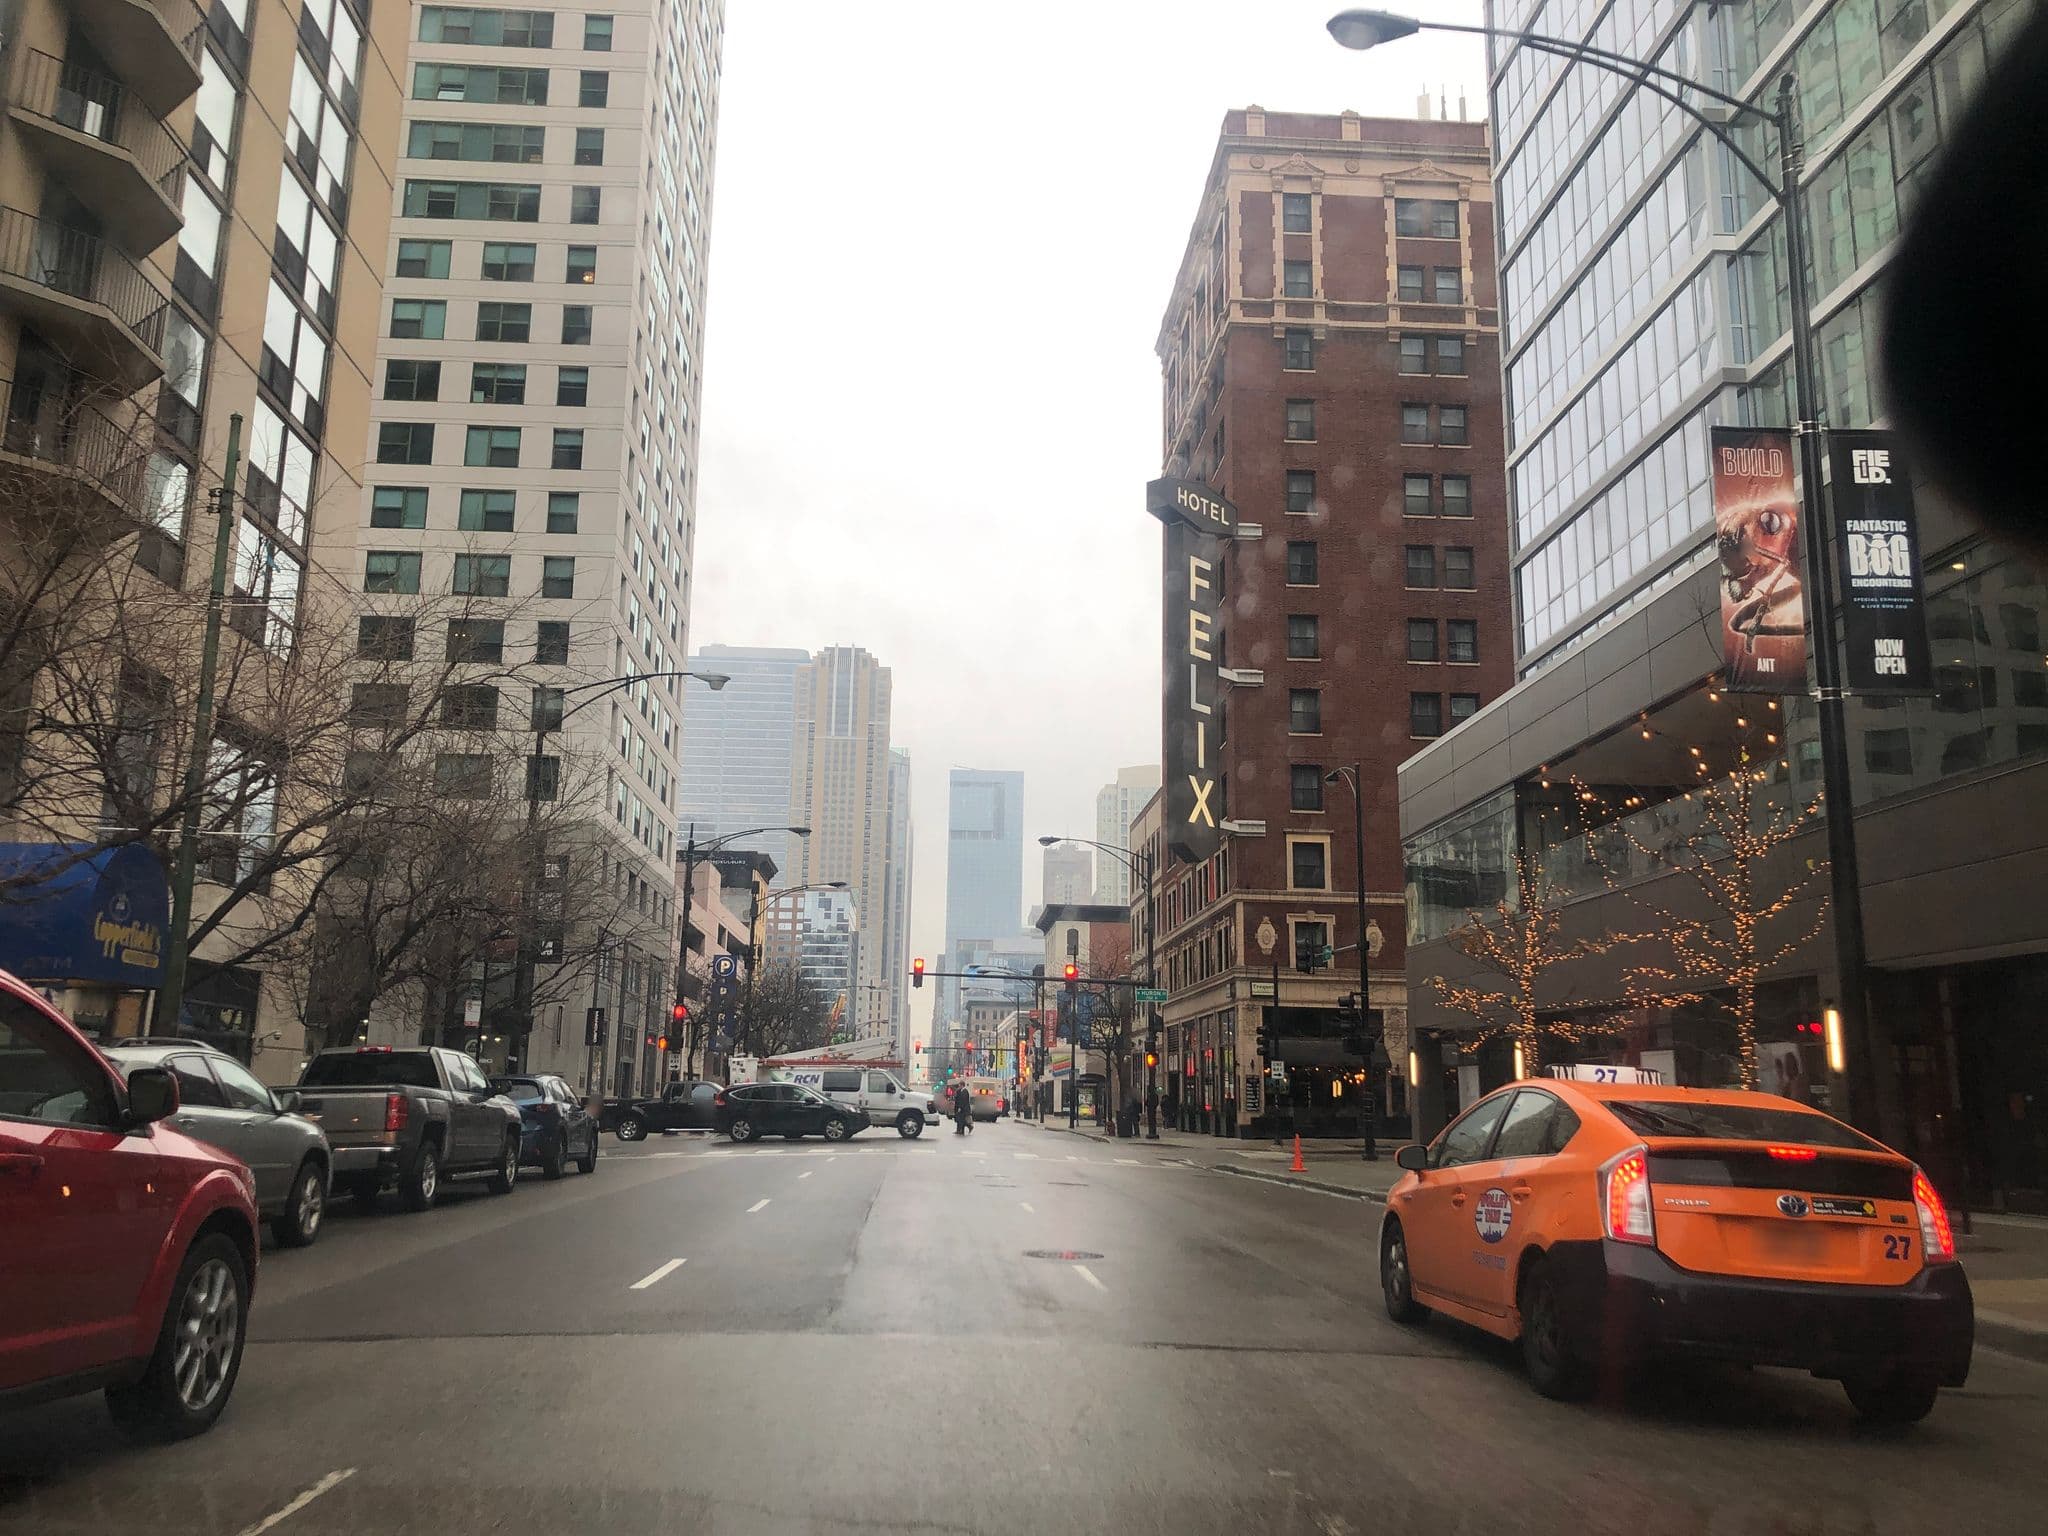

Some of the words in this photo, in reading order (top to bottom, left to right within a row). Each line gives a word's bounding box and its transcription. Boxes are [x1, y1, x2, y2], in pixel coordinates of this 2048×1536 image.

[1722, 447, 1784, 477] BUILD
[1177, 486, 1230, 527] HOTEL
[1846, 519, 1907, 532] FANTASTIC
[1874, 639, 1904, 656] NOW
[1757, 658, 1775, 672] ANT
[1874, 657, 1906, 675] OPEN
[1188, 555, 1216, 829] FELIX
[793, 1074, 821, 1084] RCN
[1551, 1065, 1577, 1080] TAXI
[1594, 1068, 1618, 1084] 27
[1635, 1070, 1662, 1086] TAXI
[1664, 1197, 1711, 1207] PRIUS
[1883, 1234, 1911, 1260] 27
